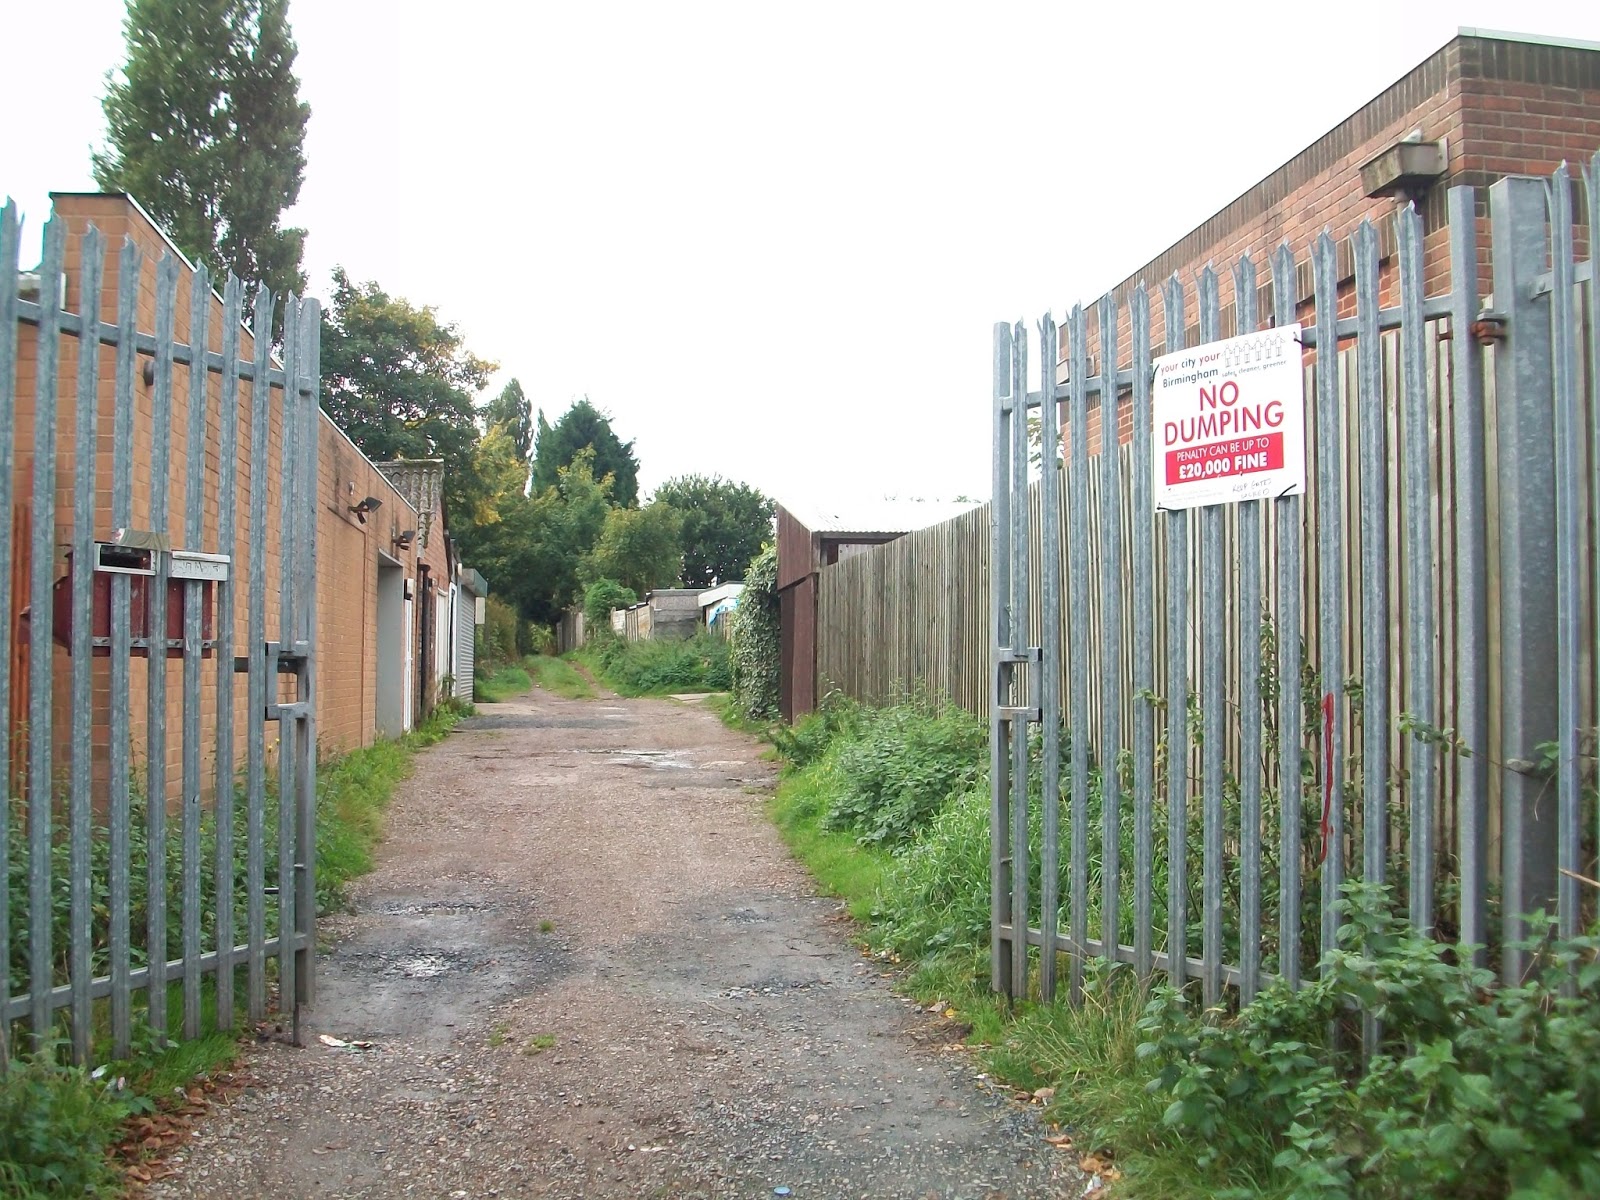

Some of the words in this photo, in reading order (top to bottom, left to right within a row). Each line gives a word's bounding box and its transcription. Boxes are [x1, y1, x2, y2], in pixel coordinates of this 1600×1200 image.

[1161, 363, 1179, 375] your
[1181, 358, 1196, 370] city
[1199, 352, 1221, 366] your
[1263, 360, 1287, 370] greener
[1163, 368, 1219, 388] Birmingham
[1200, 381, 1239, 411] NO
[1164, 400, 1284, 446] DUMPING
[1177, 448, 1208, 462] PENALTY
[1209, 444, 1228, 455] CAN
[1230, 442, 1240, 453] BE
[1242, 439, 1254, 451] UP
[1256, 437, 1270, 448] TO
[1179, 458, 1230, 479] £20,000
[1234, 452, 1267, 469] FINE
